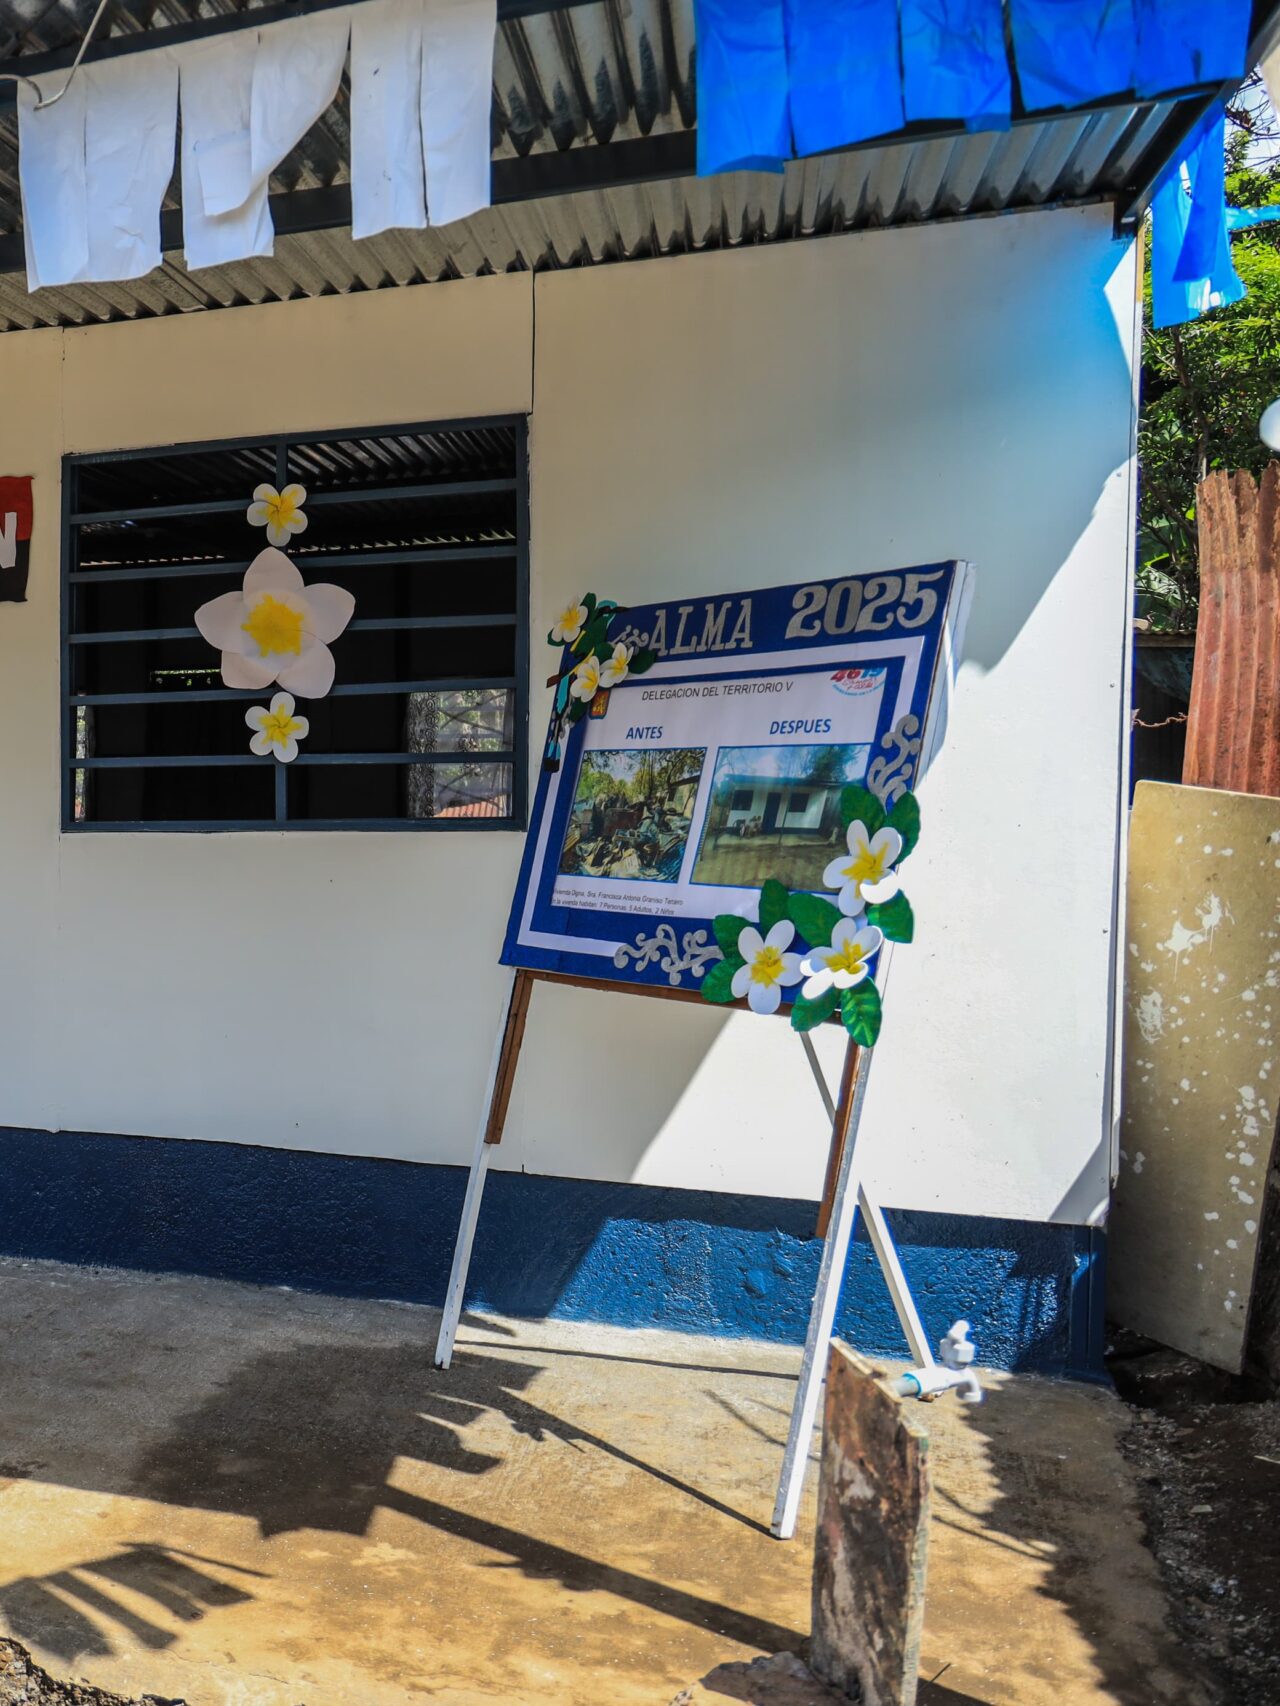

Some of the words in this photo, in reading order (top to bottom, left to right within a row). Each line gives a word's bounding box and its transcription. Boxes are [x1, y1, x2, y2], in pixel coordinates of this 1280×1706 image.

[648, 598, 753, 656] ALMA
[785, 569, 945, 640] 2025
[641, 686, 700, 701] DELEGACION
[702, 686, 719, 697] DEL
[722, 681, 783, 695] TERRITORIO
[785, 681, 794, 691] V
[625, 726, 664, 740] ANTES
[769, 718, 832, 735] DESPUES
